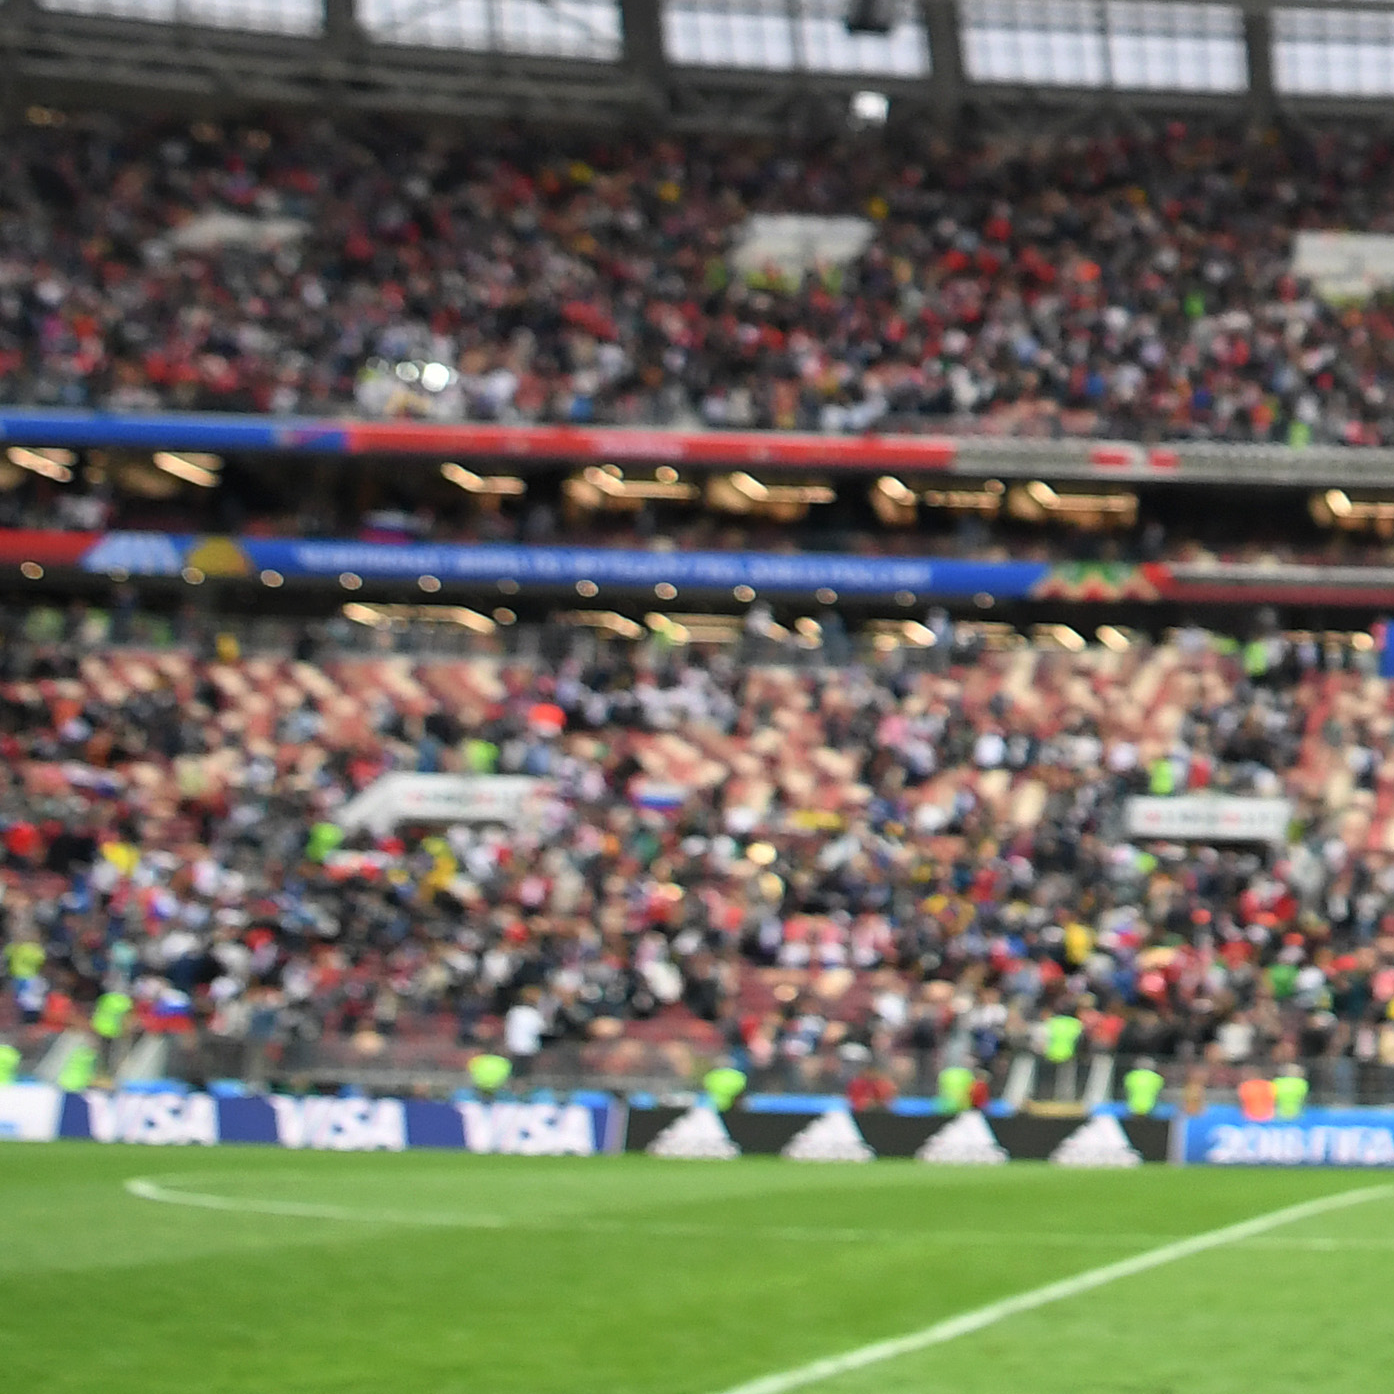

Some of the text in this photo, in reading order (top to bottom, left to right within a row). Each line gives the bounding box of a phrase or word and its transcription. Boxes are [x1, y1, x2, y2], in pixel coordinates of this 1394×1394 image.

[86, 1092, 219, 1147] VISA
[271, 1095, 408, 1151] VISA
[457, 1099, 598, 1155] VISA
[1206, 1125, 1308, 1164] 2018
[1312, 1126, 1394, 1165] FIFA
